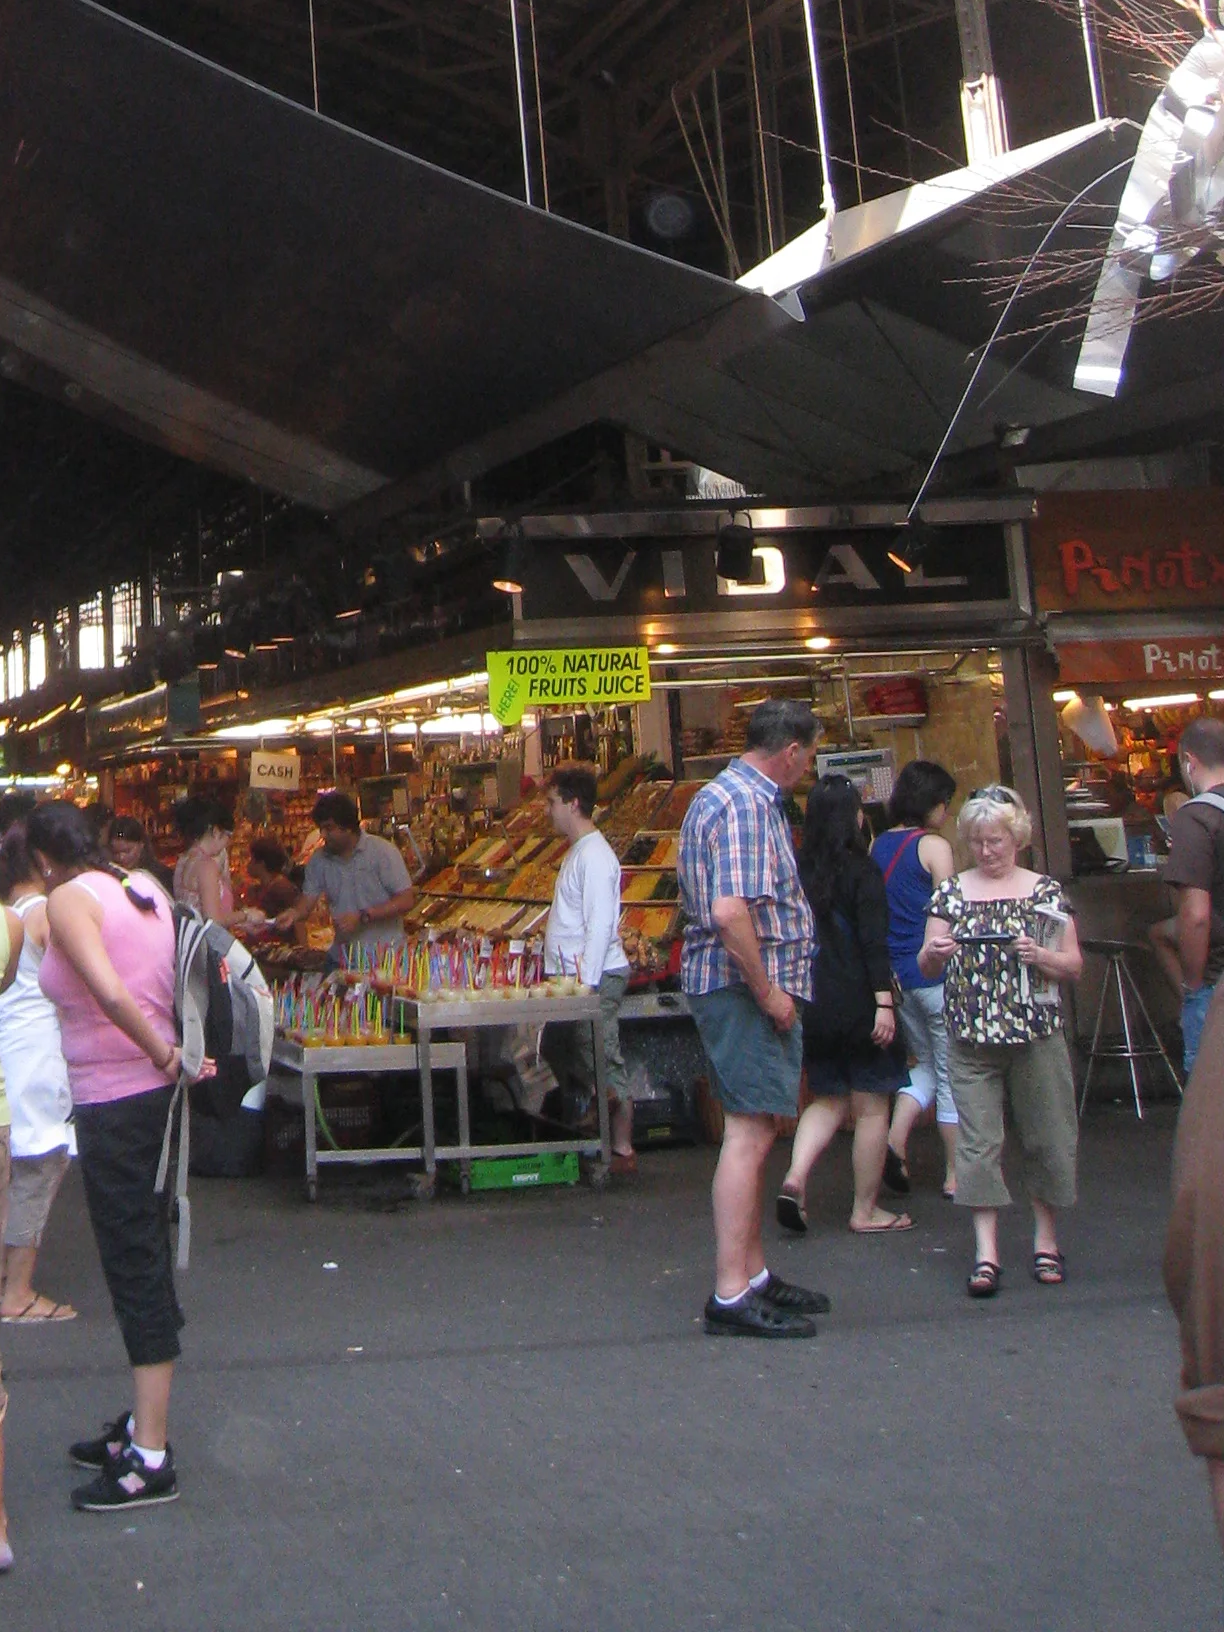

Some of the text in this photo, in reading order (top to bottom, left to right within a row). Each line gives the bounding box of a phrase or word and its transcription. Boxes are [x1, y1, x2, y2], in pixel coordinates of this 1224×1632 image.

[563, 544, 968, 601] VIDAL
[506, 652, 642, 676] 100% NATURAL
[529, 674, 645, 698] FRUITS JUICE
[257, 764, 293, 779] CASH
